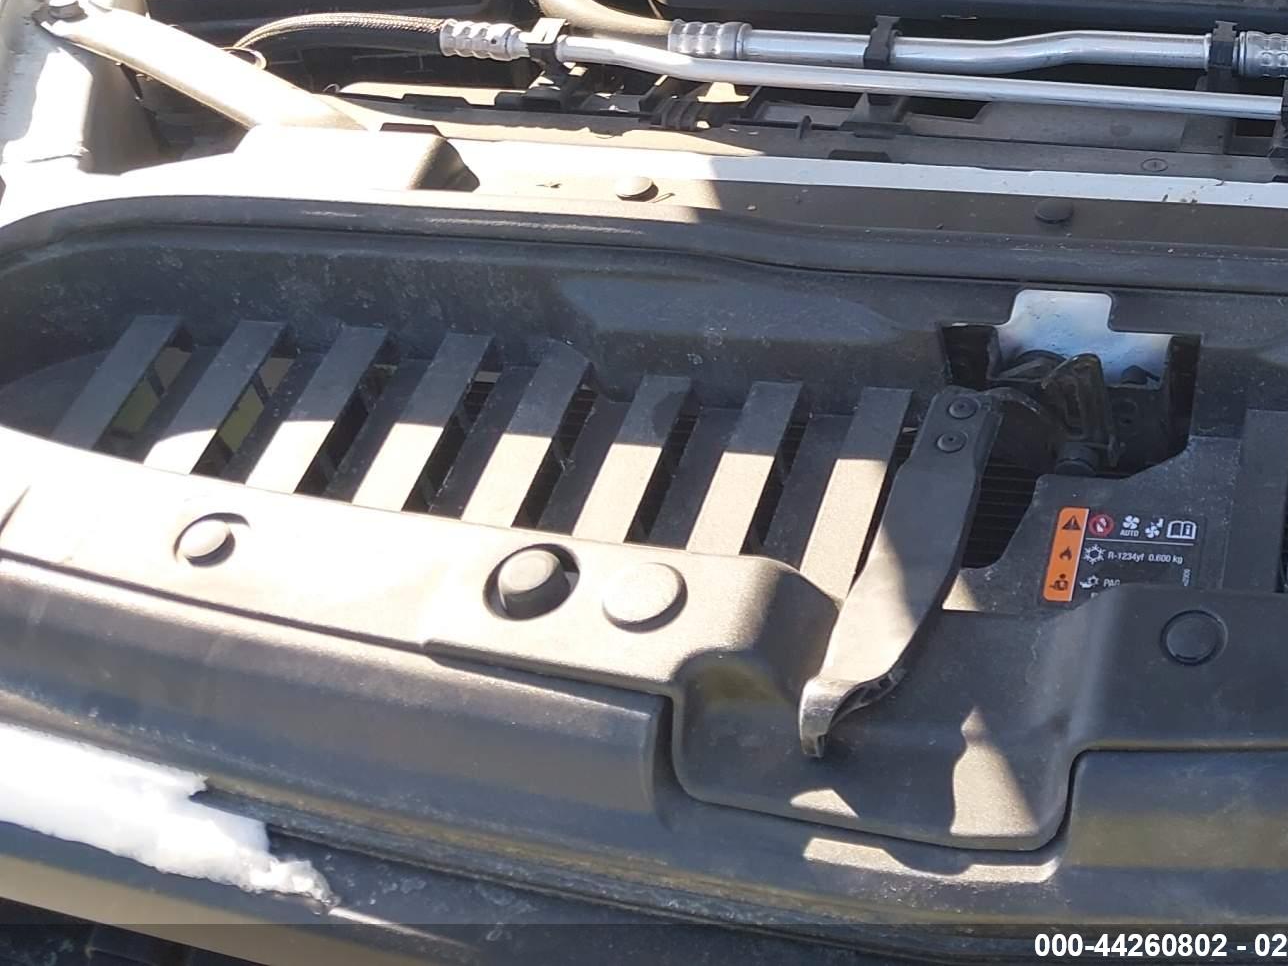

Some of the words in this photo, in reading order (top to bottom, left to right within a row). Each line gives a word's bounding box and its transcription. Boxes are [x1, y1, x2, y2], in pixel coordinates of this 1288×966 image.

[1119, 529, 1139, 537] AUTO
[1107, 550, 1145, 563] R-1234yf
[1148, 553, 1171, 563] 0.600
[1172, 554, 1183, 565] kg
